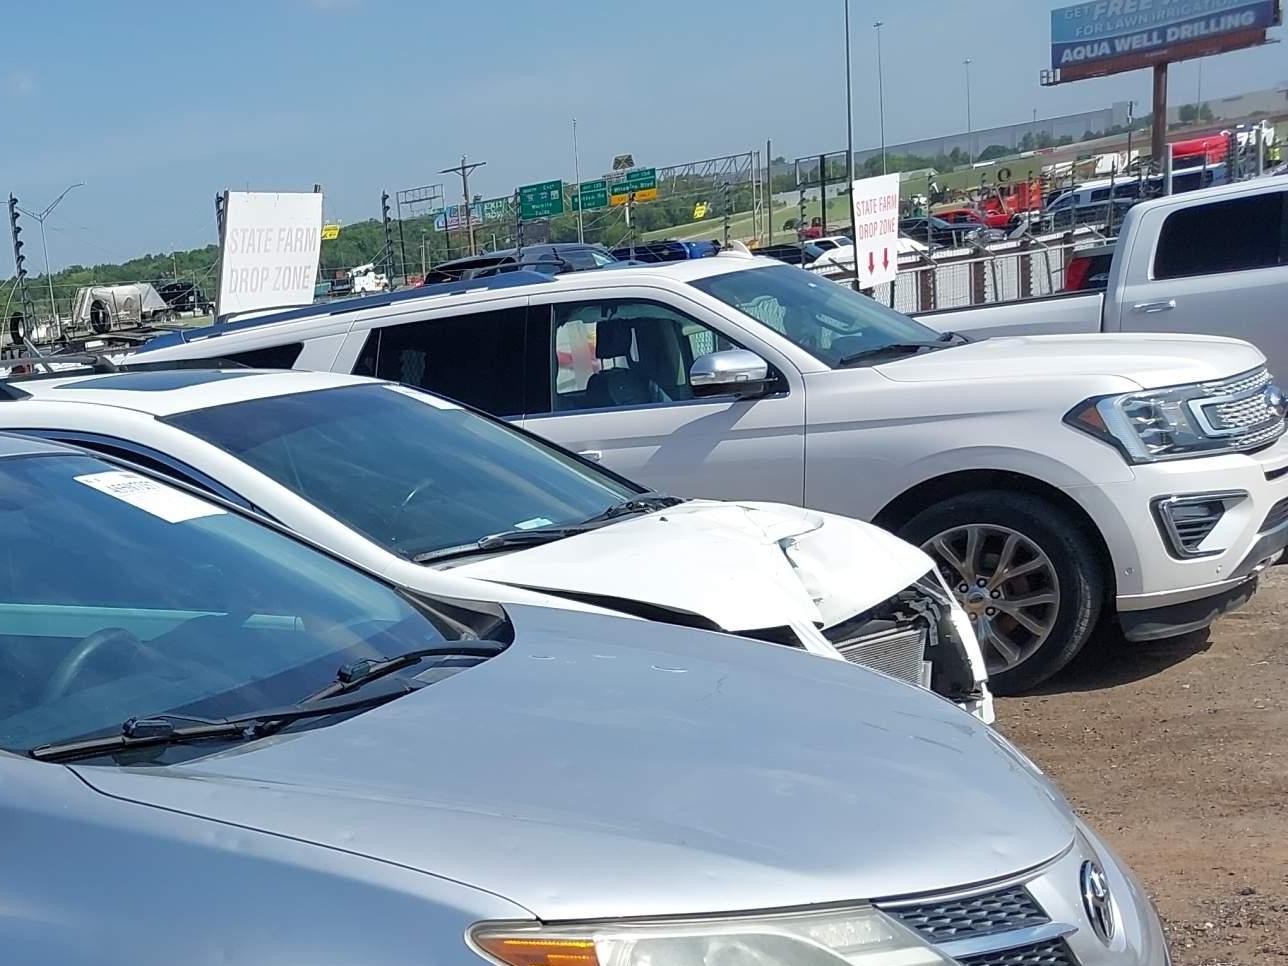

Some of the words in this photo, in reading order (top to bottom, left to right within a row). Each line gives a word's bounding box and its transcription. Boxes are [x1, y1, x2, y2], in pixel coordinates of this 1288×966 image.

[1064, 6, 1092, 20] GET
[1093, 0, 1153, 20] FREE
[1075, 23, 1104, 37] FOR
[1104, 14, 1148, 31] LAWN
[1061, 41, 1111, 64] AQUA
[1114, 30, 1162, 53] WELL
[1165, 11, 1255, 42] DRILLING
[856, 198, 877, 217] STATE
[879, 194, 897, 212] FARM
[229, 227, 273, 254] STATE
[276, 226, 317, 253] FARM
[859, 222, 878, 240] DROP
[879, 217, 895, 235] ZONE
[229, 267, 269, 294] DROP
[272, 265, 311, 291] ZONE
